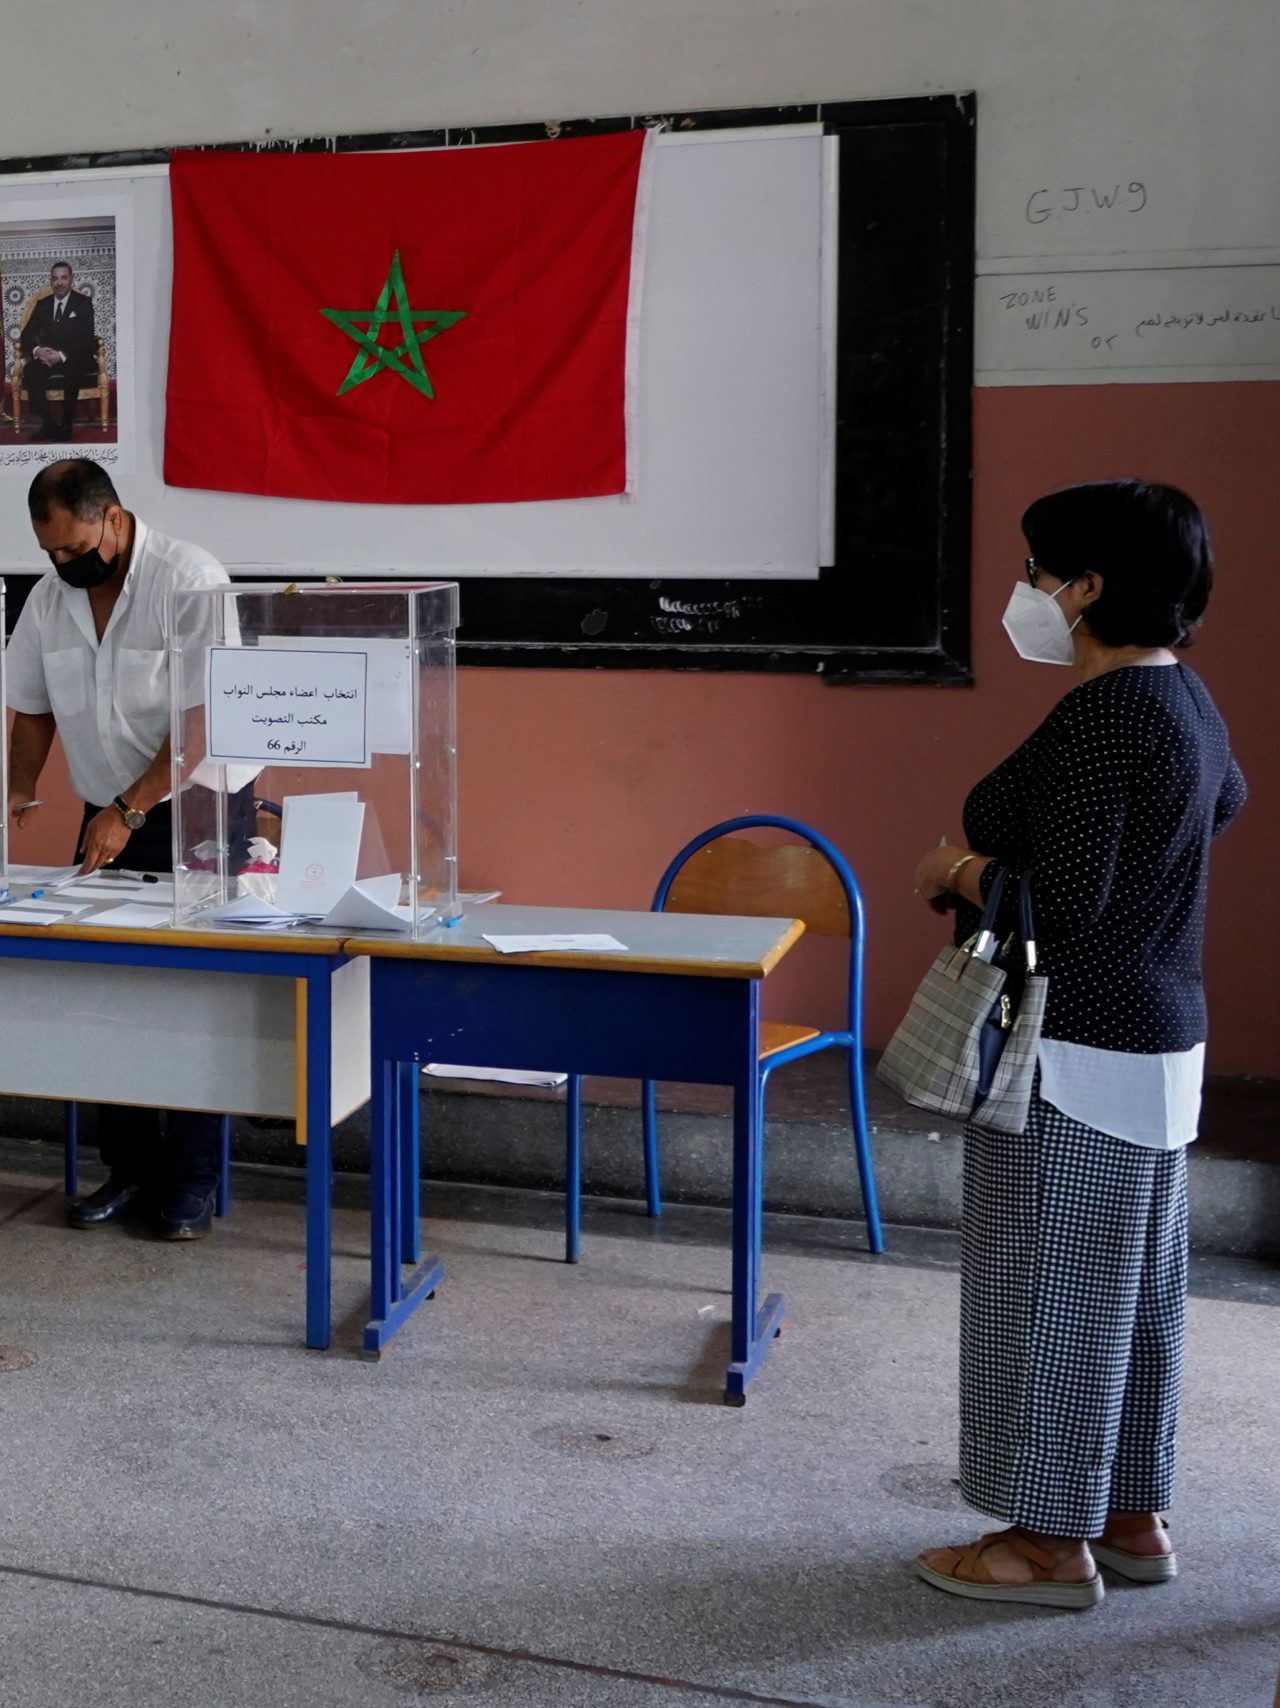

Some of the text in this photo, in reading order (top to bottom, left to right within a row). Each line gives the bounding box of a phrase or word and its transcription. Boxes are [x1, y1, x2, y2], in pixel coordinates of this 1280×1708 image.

[999, 286, 1057, 309] ZONE
[224, 685, 357, 701] انتخاب اعضاء مجلس النواب
[252, 713, 327, 728] مكتب التصويت
[267, 739, 306, 755] الرقم 66
